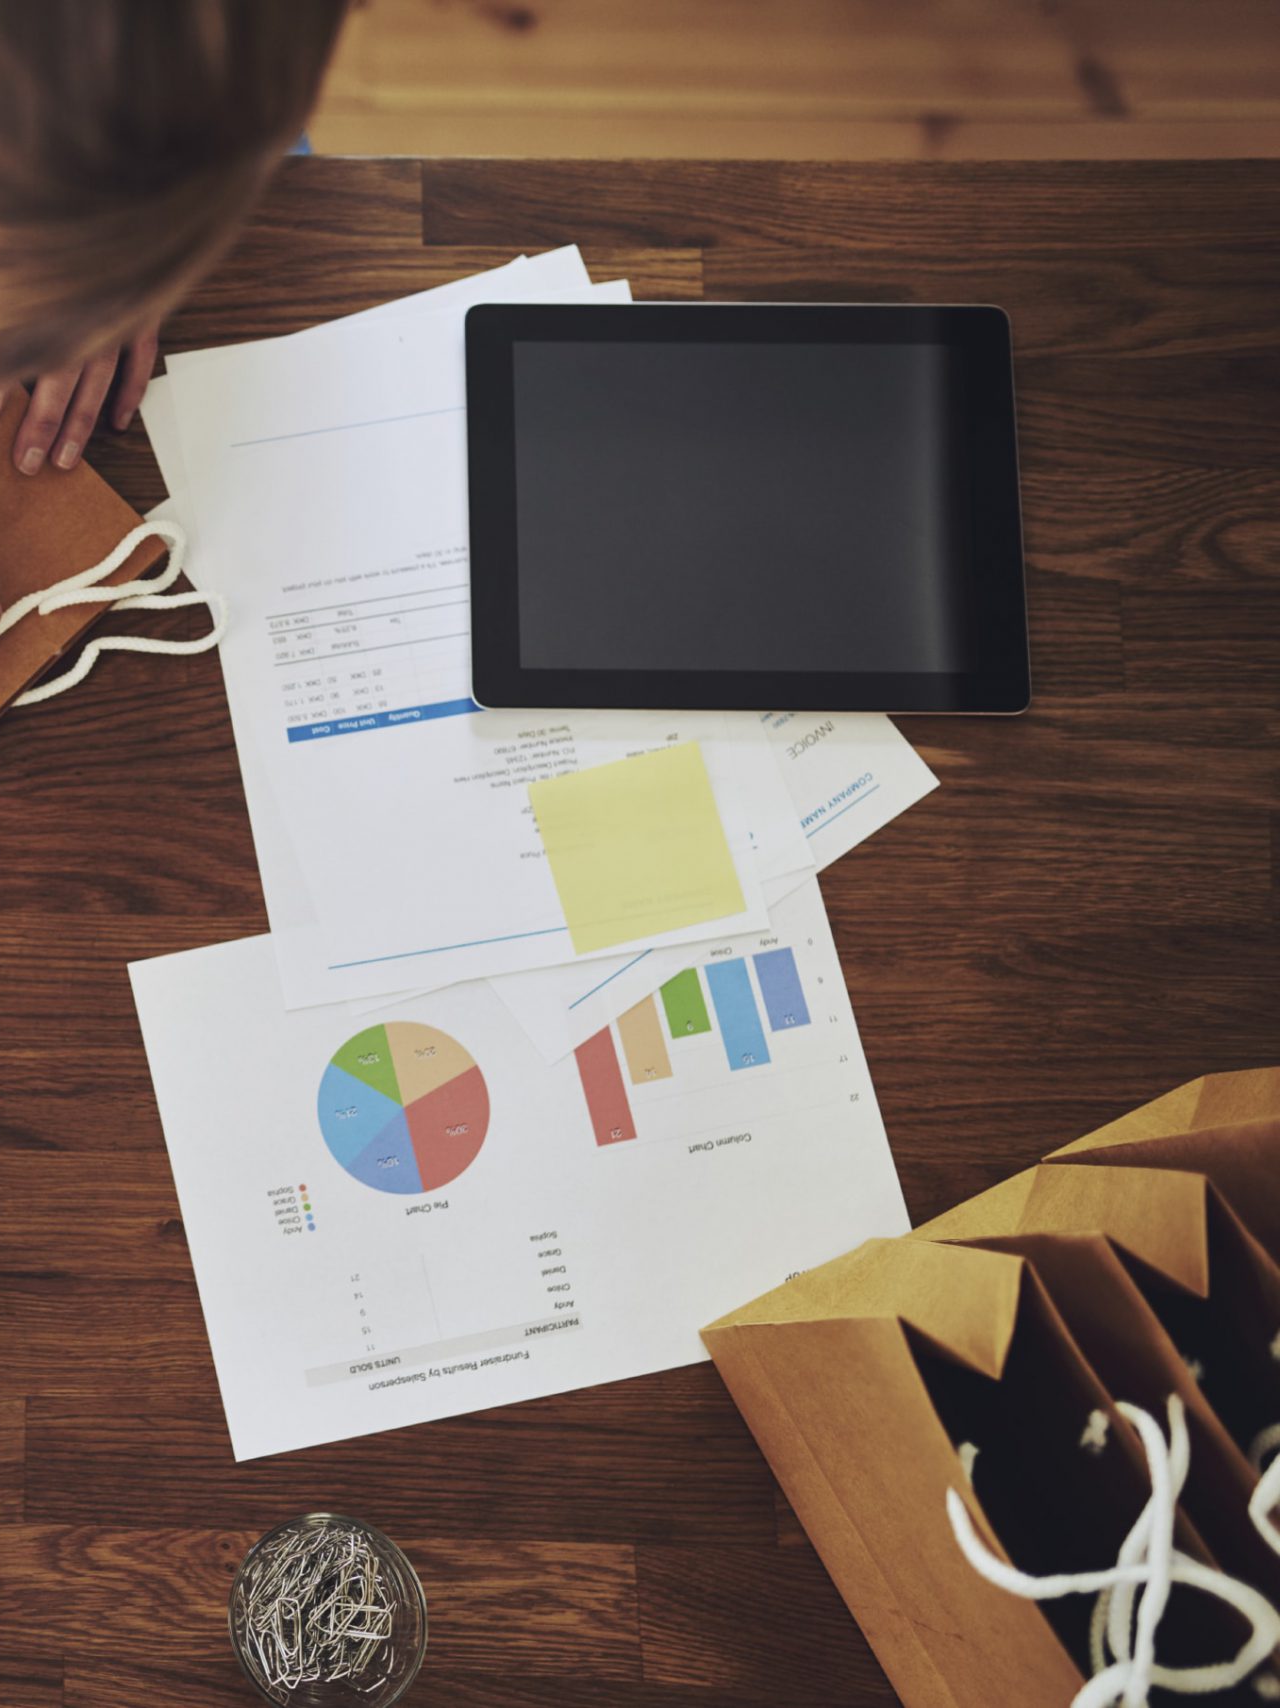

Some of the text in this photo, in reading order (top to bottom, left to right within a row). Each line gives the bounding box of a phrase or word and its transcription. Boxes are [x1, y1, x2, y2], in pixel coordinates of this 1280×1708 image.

[311, 710, 420, 735] Quantity Unit Price Cost
[786, 720, 835, 760] INVOICE
[826, 772, 873, 809] COMPANY
[759, 936, 778, 948] Andy
[688, 1132, 752, 1154] Column Chart
[405, 1200, 449, 1217] Pie Chart
[530, 1230, 558, 1243] Sophia
[538, 1248, 562, 1259] Grace
[541, 1265, 566, 1277] Daniel
[547, 1283, 570, 1295] Chloe
[554, 1300, 574, 1311] Andy
[524, 1318, 579, 1336] PARTICIPANT
[350, 1357, 401, 1374] UNITS SOLD
[368, 1350, 529, 1391] Fundraiser Results by Salesperson
